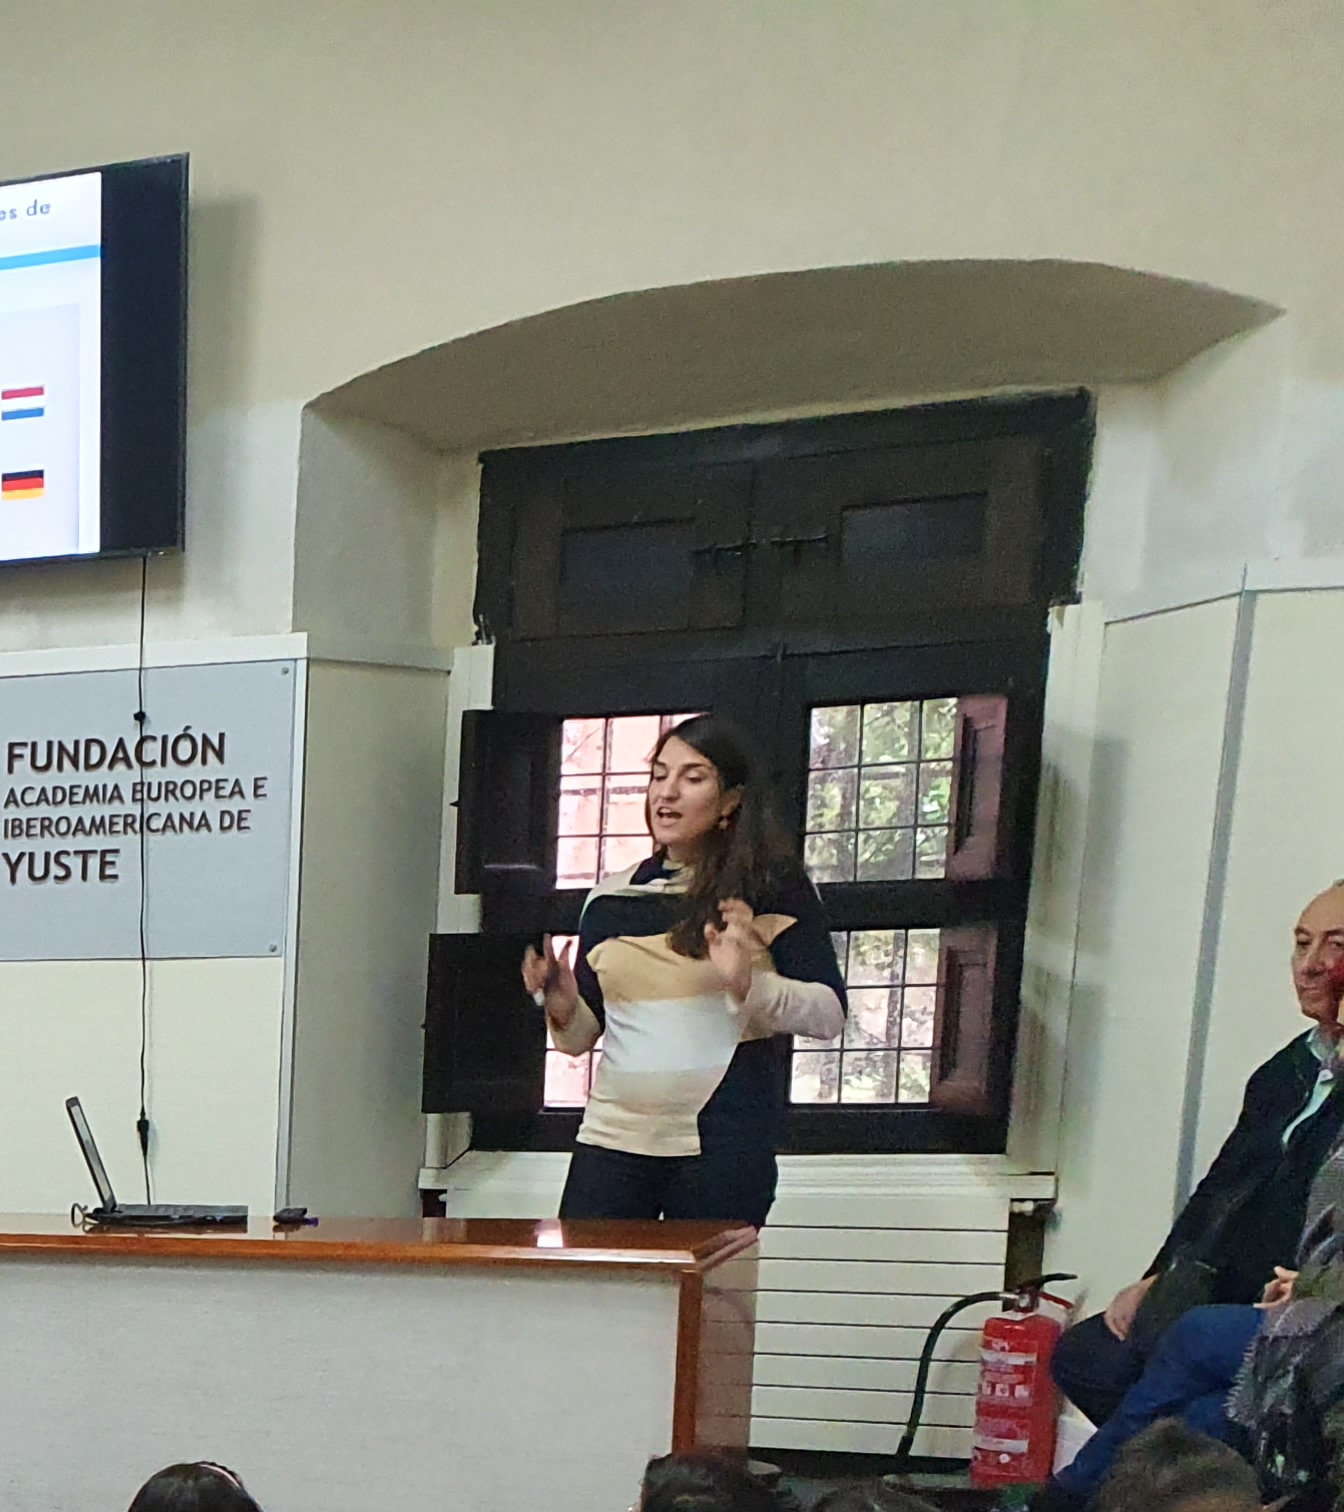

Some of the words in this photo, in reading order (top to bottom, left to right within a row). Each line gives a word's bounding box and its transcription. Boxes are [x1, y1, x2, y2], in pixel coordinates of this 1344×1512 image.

[26, 199, 51, 216] de
[6, 725, 226, 775] FUNDACIÓN
[3, 782, 125, 809] ACADEMIA
[131, 778, 246, 803] EUROPEA
[252, 776, 268, 798] E
[3, 810, 212, 840] IBEROAMERICANA
[218, 809, 252, 832] DE
[1, 848, 121, 886] YUSTE
